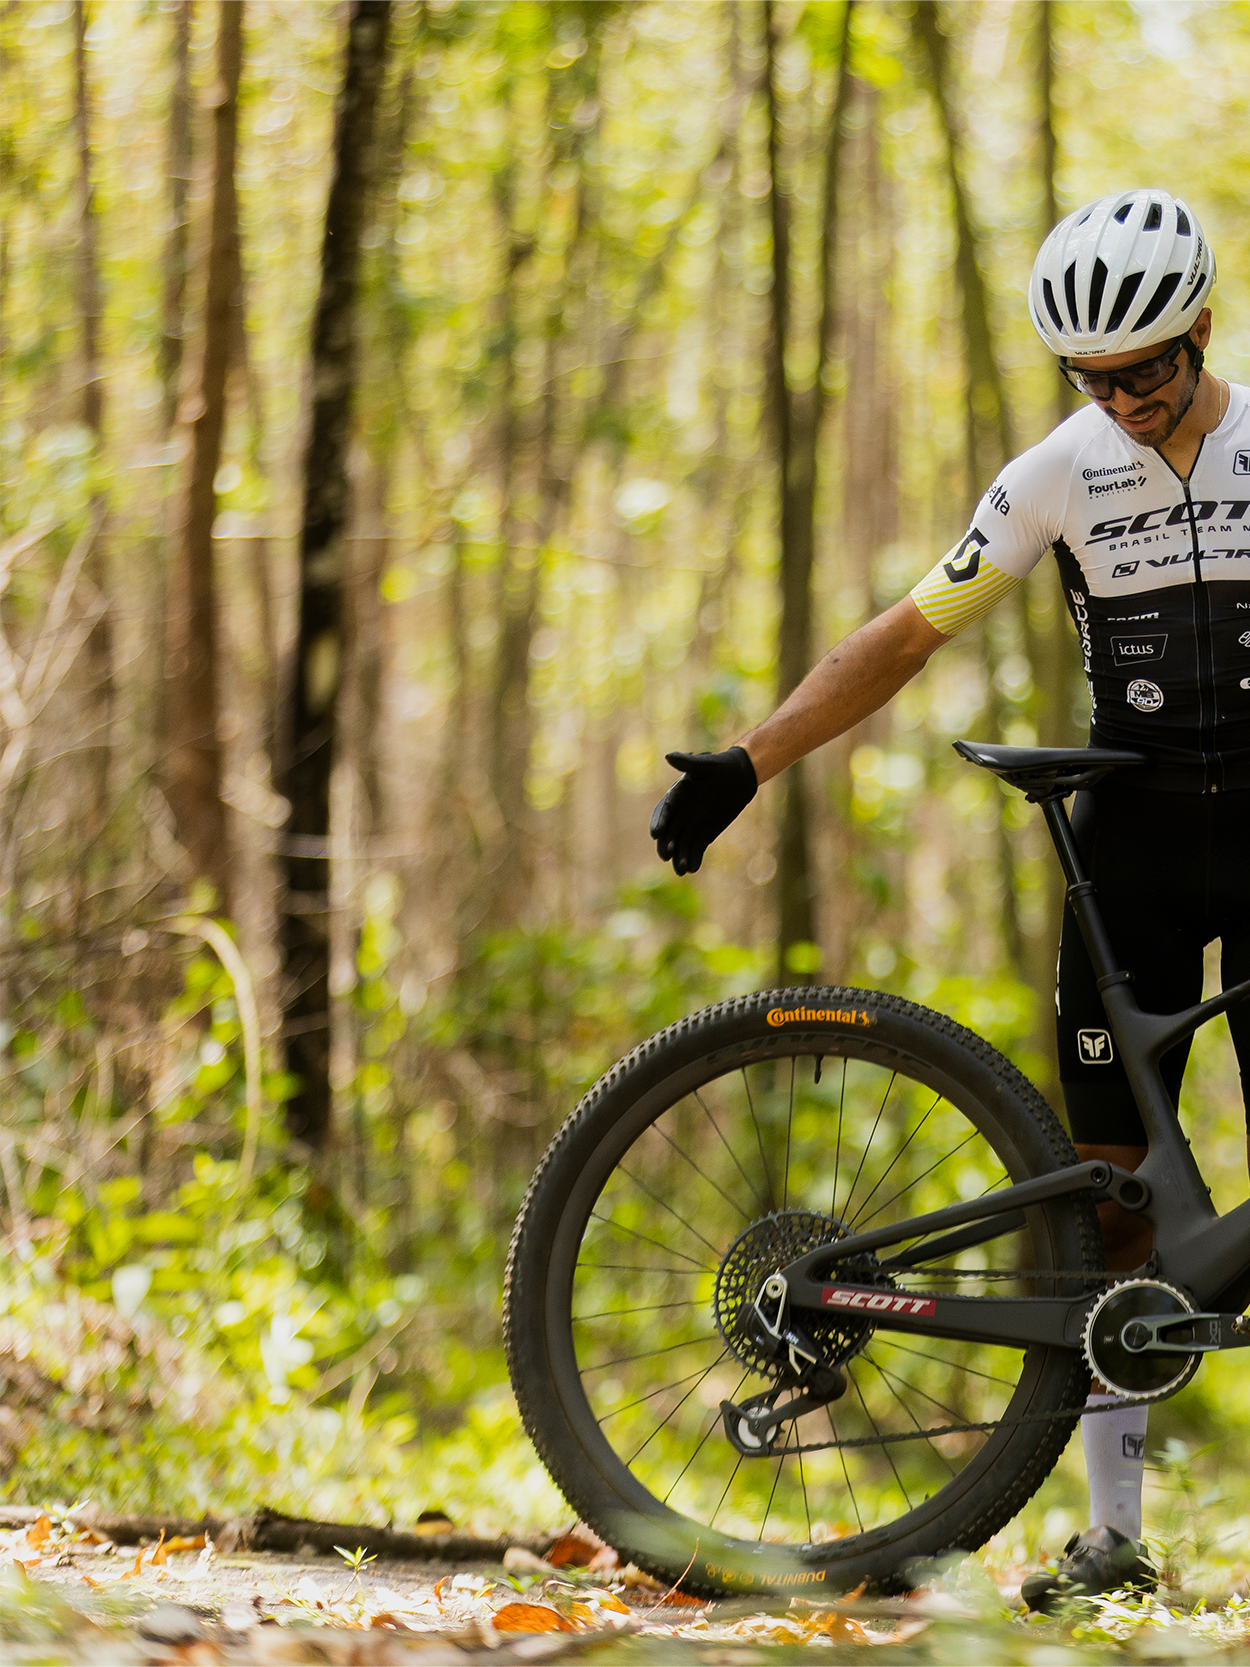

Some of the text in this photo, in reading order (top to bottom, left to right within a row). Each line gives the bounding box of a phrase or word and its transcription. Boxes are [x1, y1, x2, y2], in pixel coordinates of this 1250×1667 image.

[1082, 462, 1137, 481] Continental
[1088, 478, 1136, 495] FourLab
[1109, 533, 1170, 551] BRASIL
[1181, 525, 1232, 536] TEAM
[1070, 589, 1092, 673] FORCE
[1119, 643, 1154, 655] ictus
[766, 1006, 857, 1027] Continental
[827, 1290, 931, 1314] SCOTT
[761, 1569, 827, 1586] DUBNITAL
